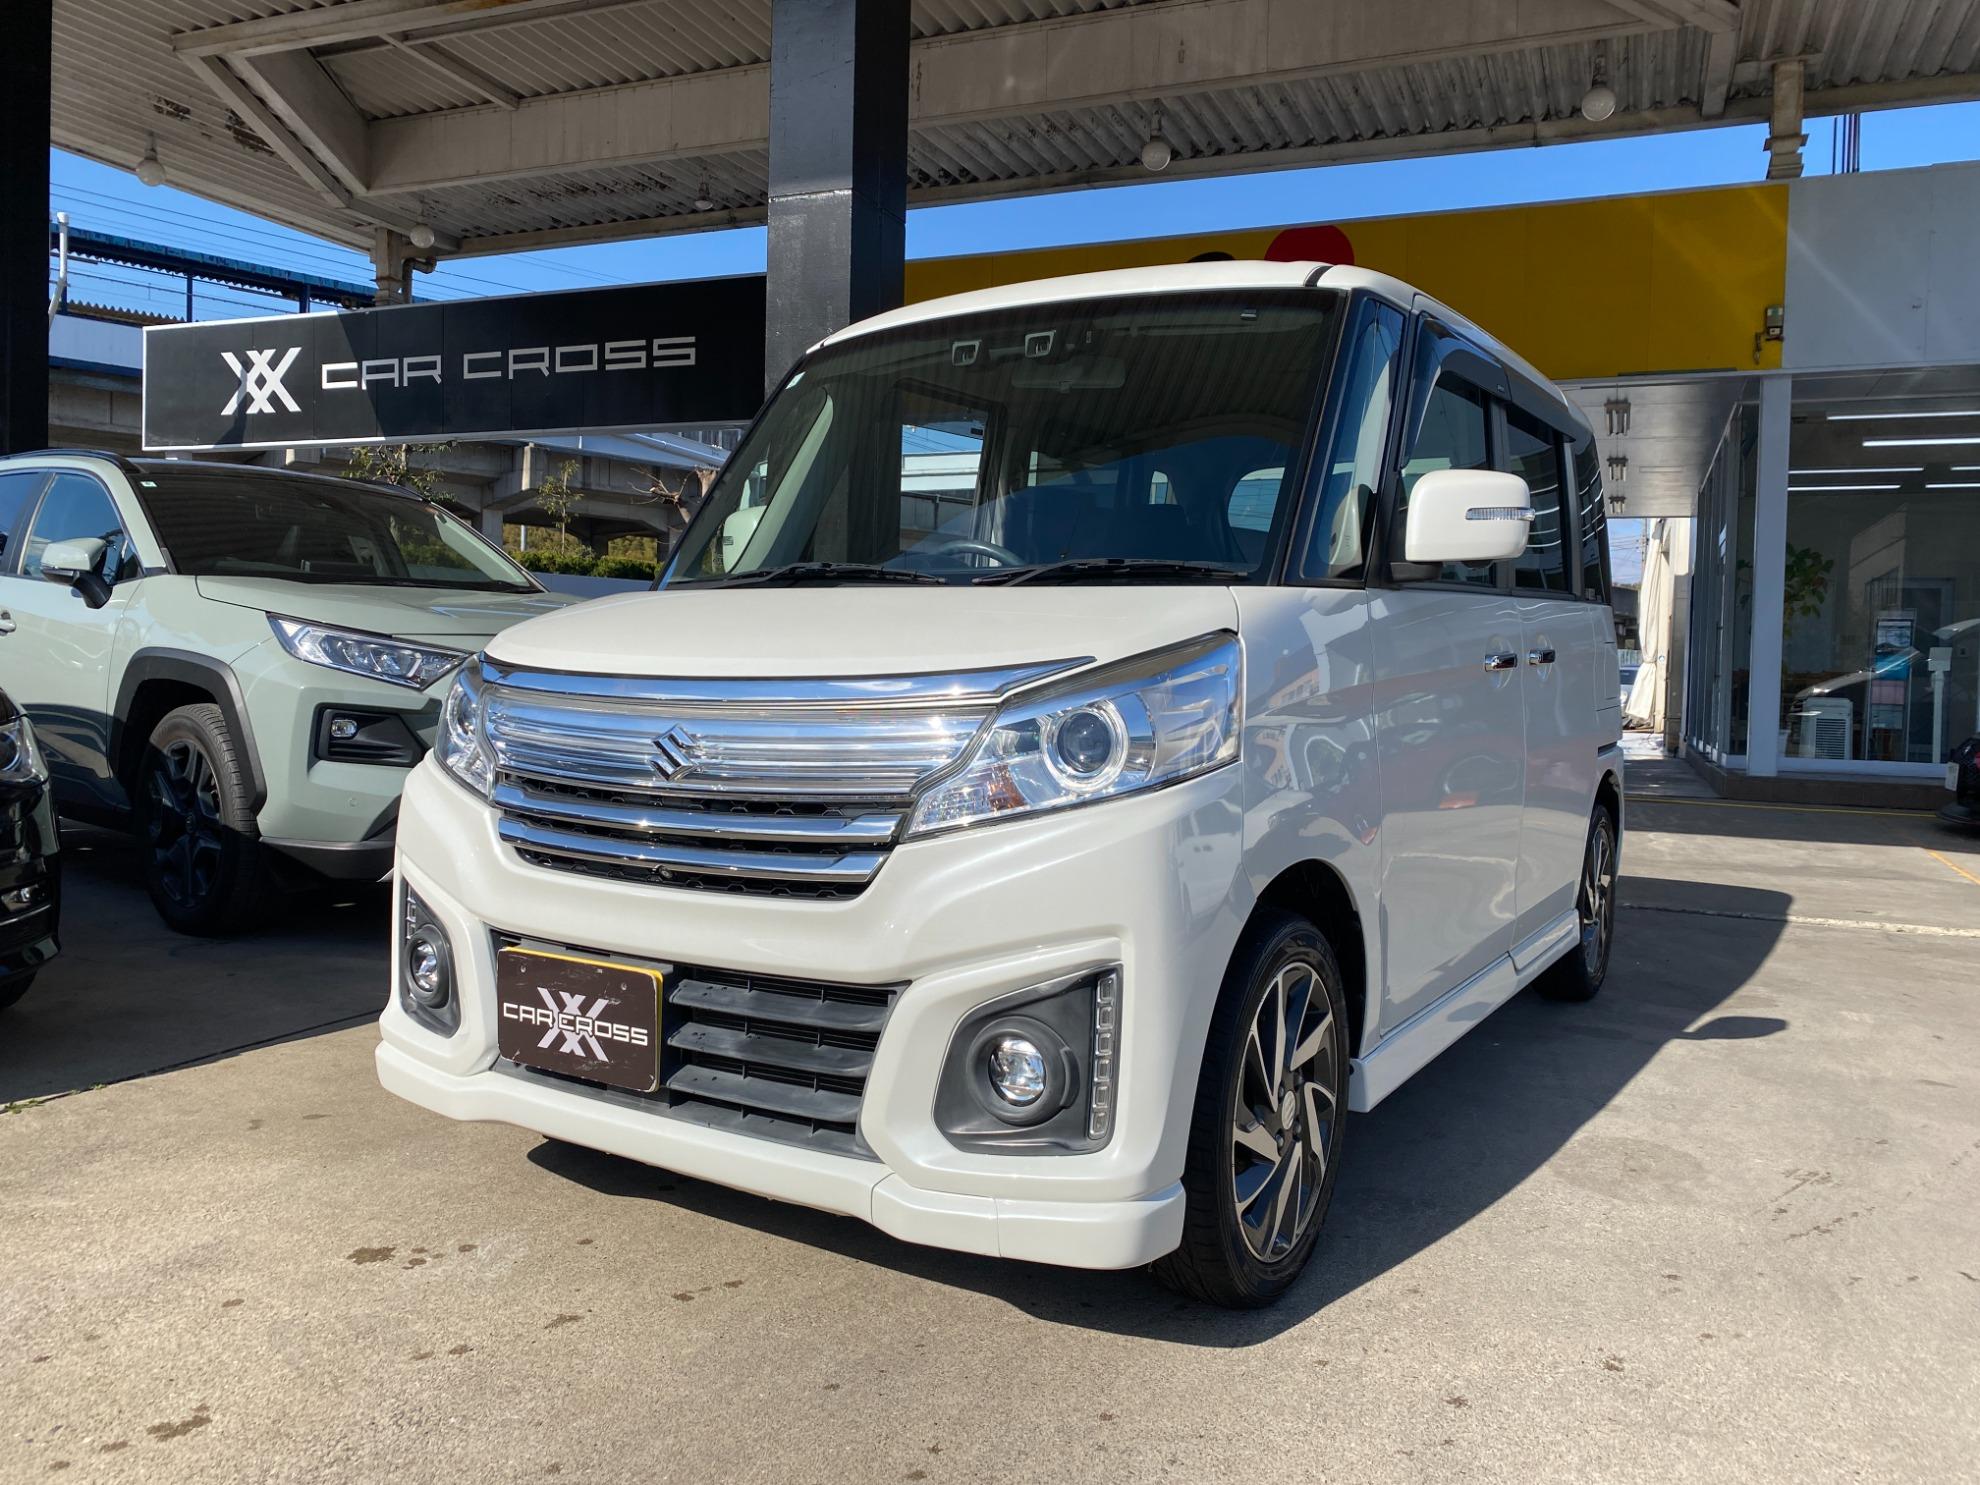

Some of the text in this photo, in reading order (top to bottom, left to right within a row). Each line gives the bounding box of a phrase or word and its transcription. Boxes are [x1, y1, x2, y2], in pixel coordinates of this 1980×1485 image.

[321, 337, 696, 390] CAR CROSS
[503, 1002, 648, 1046] CAR CROSS
